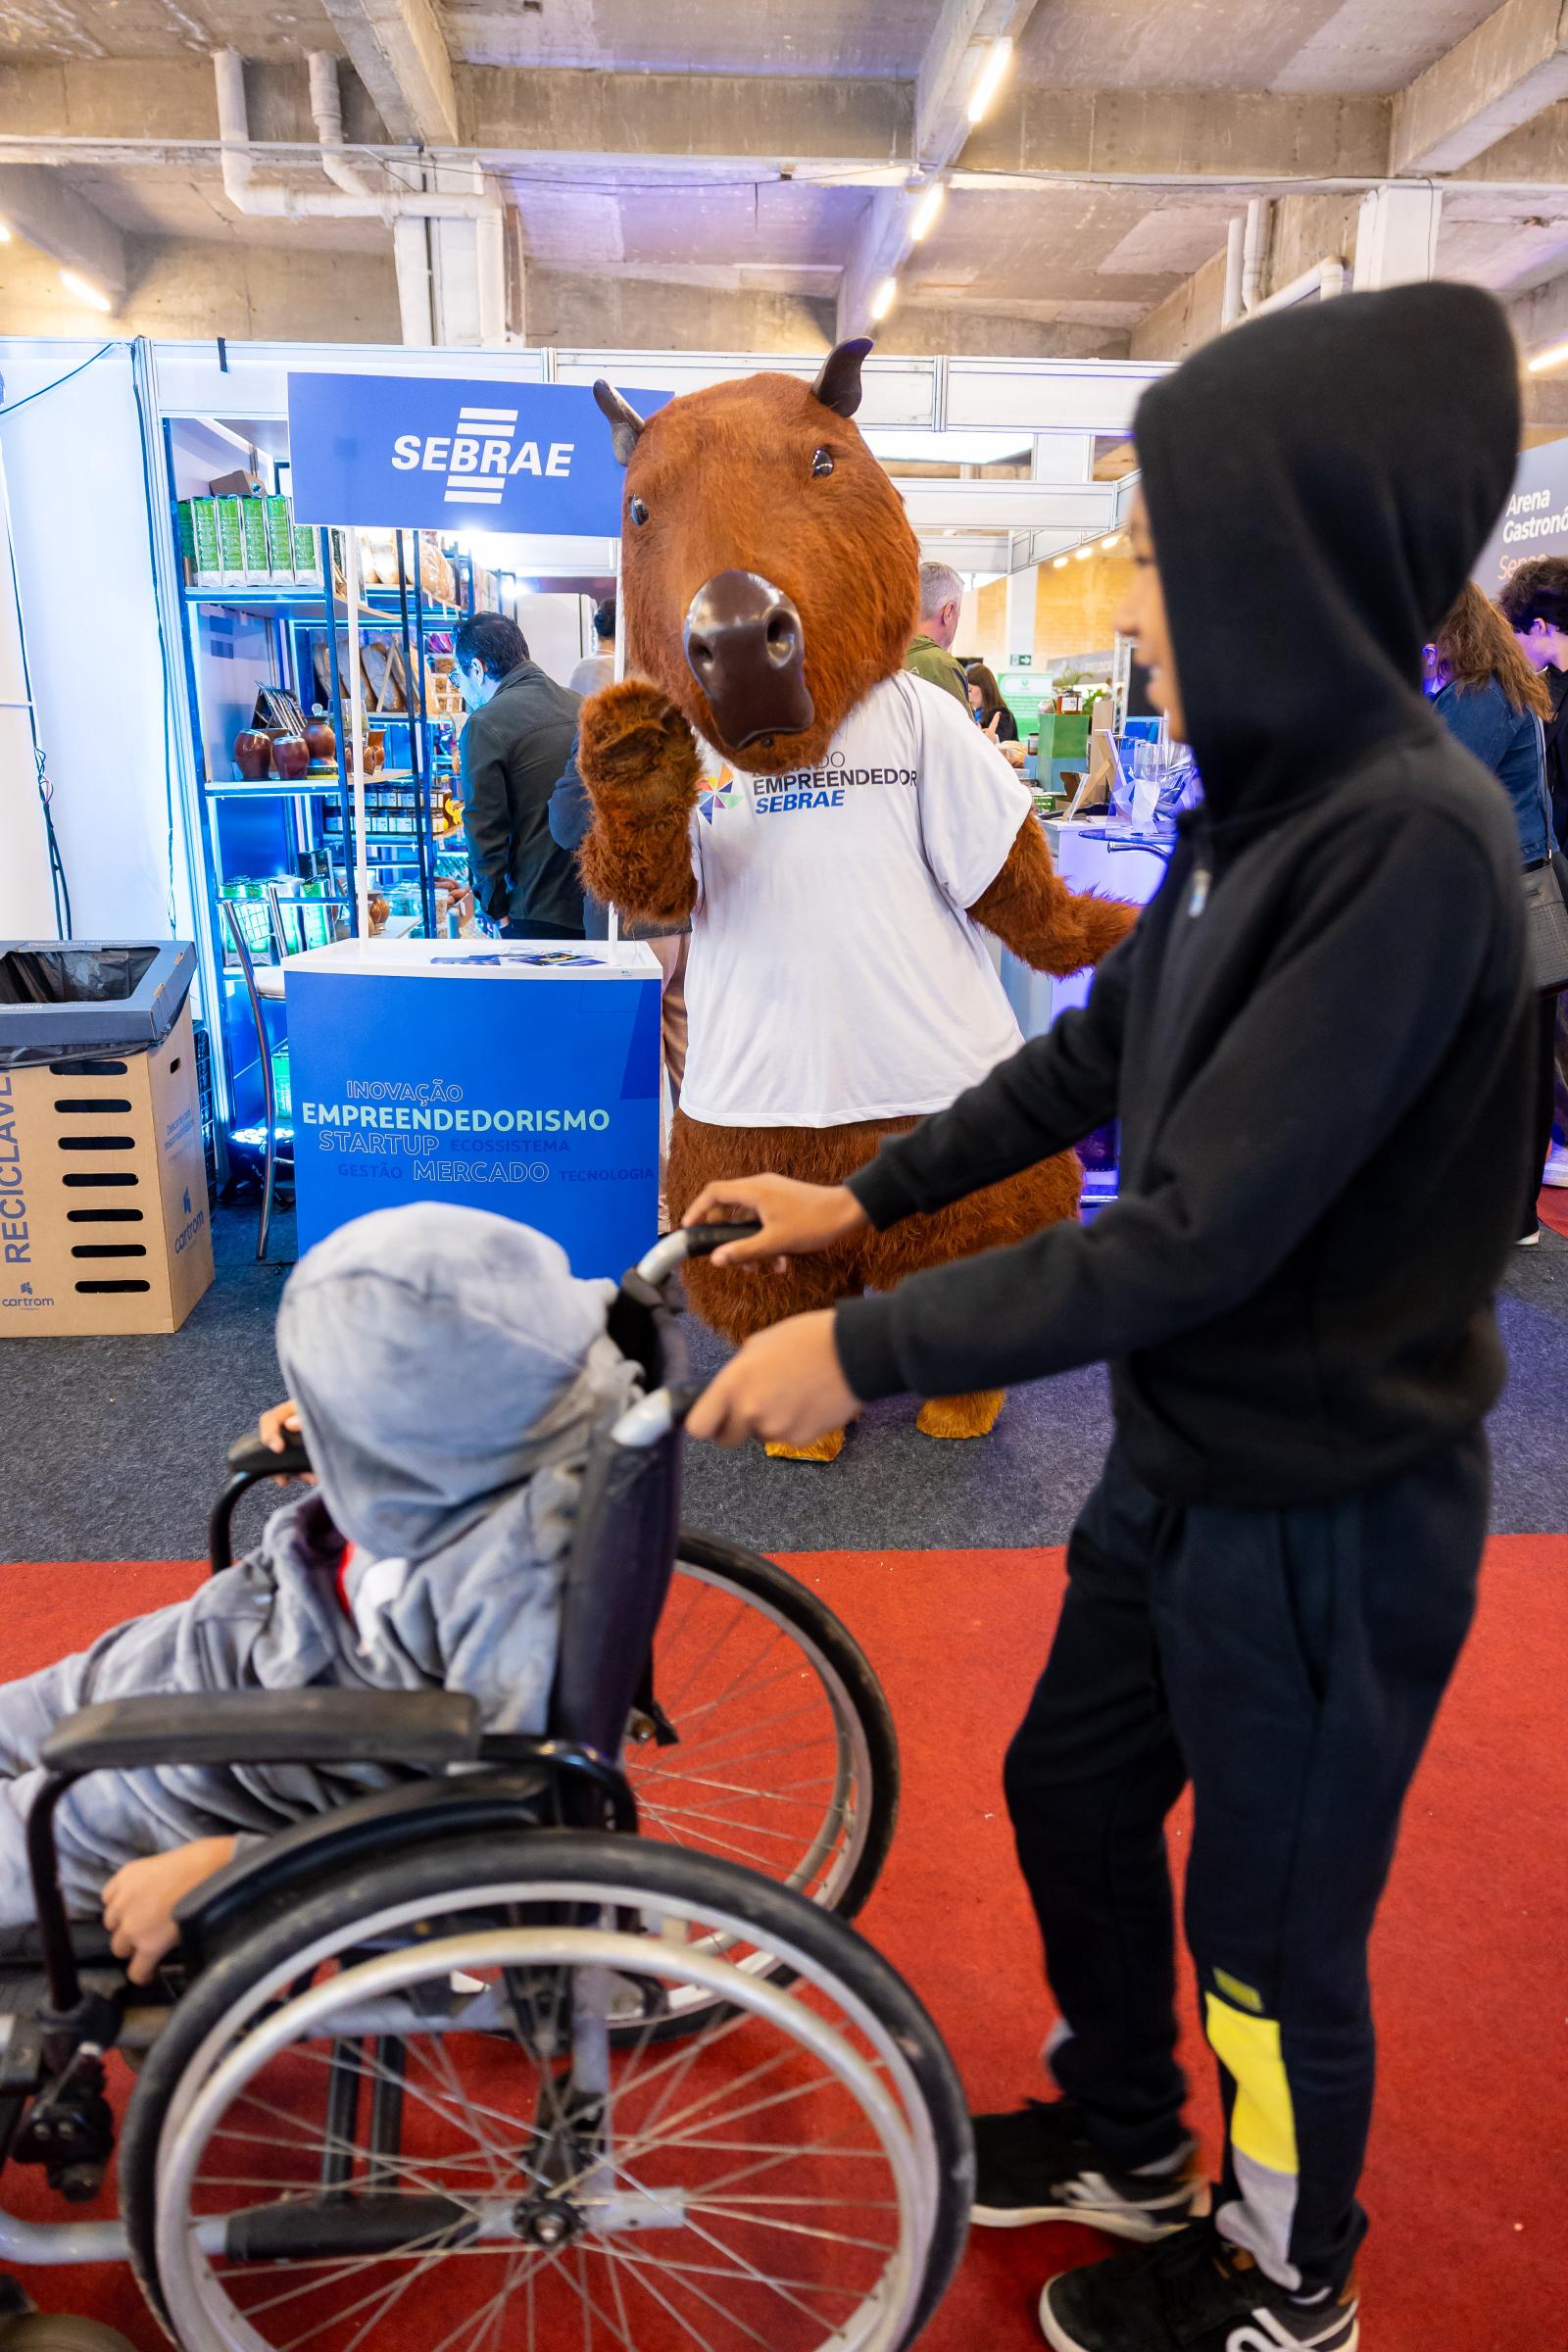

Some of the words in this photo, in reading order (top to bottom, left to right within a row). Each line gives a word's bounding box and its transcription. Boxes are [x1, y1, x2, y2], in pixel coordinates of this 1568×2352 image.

[392, 434, 575, 477] SEBRAE
[1505, 489, 1550, 517] Arena
[753, 768, 917, 796] EMPREENDEDOR
[755, 789, 846, 814] SEBRAE
[346, 1078, 464, 1106] INOVAÇÃO
[302, 1102, 611, 1132] EMPREENDEDORISMO
[318, 1130, 440, 1155] STARTUP
[450, 1139, 570, 1154] ECOSSISTEMA
[337, 1161, 403, 1180] GESTÃO
[413, 1159, 550, 1183] MERCADO
[559, 1167, 655, 1182] TECNOLOGIA
[174, 1209, 205, 1254] cartrom
[2, 1296, 55, 1307] cartrom
